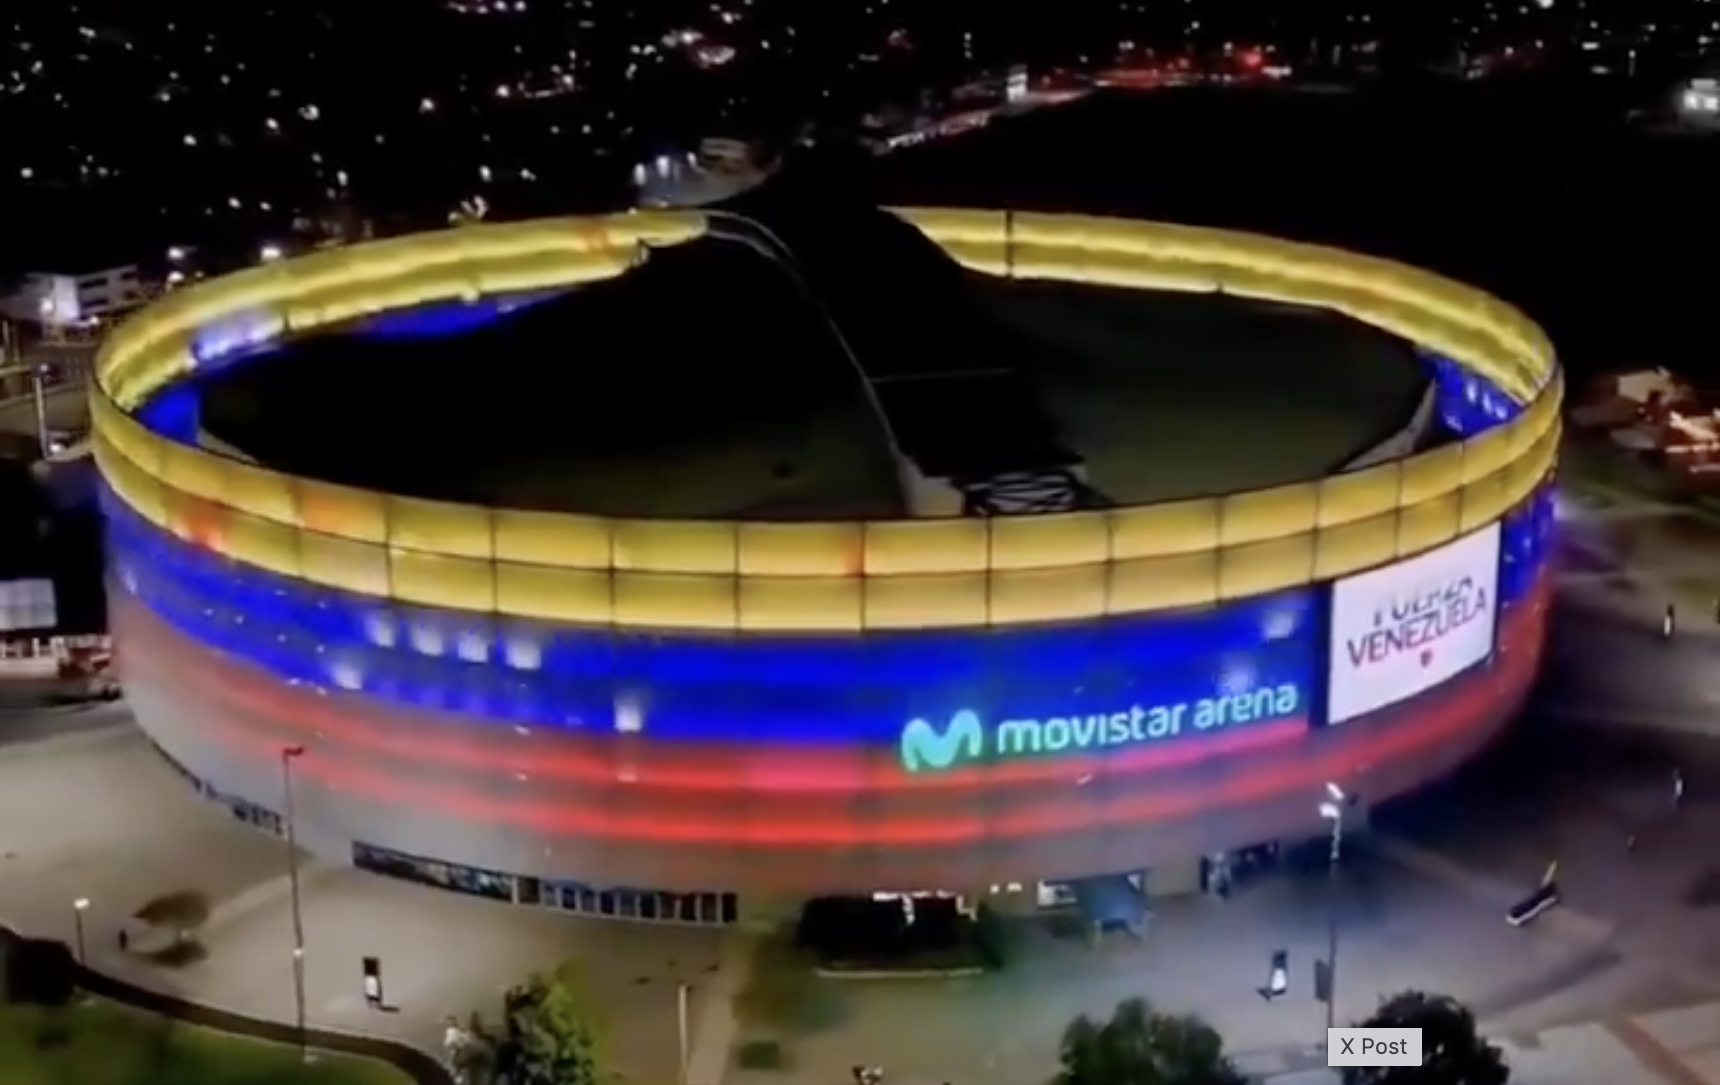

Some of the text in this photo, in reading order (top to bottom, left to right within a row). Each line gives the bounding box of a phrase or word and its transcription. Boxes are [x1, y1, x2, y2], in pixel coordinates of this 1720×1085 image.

[1347, 587, 1486, 668] VENEZUELA
[997, 703, 1187, 753] movistar
[1194, 683, 1298, 728] arena
